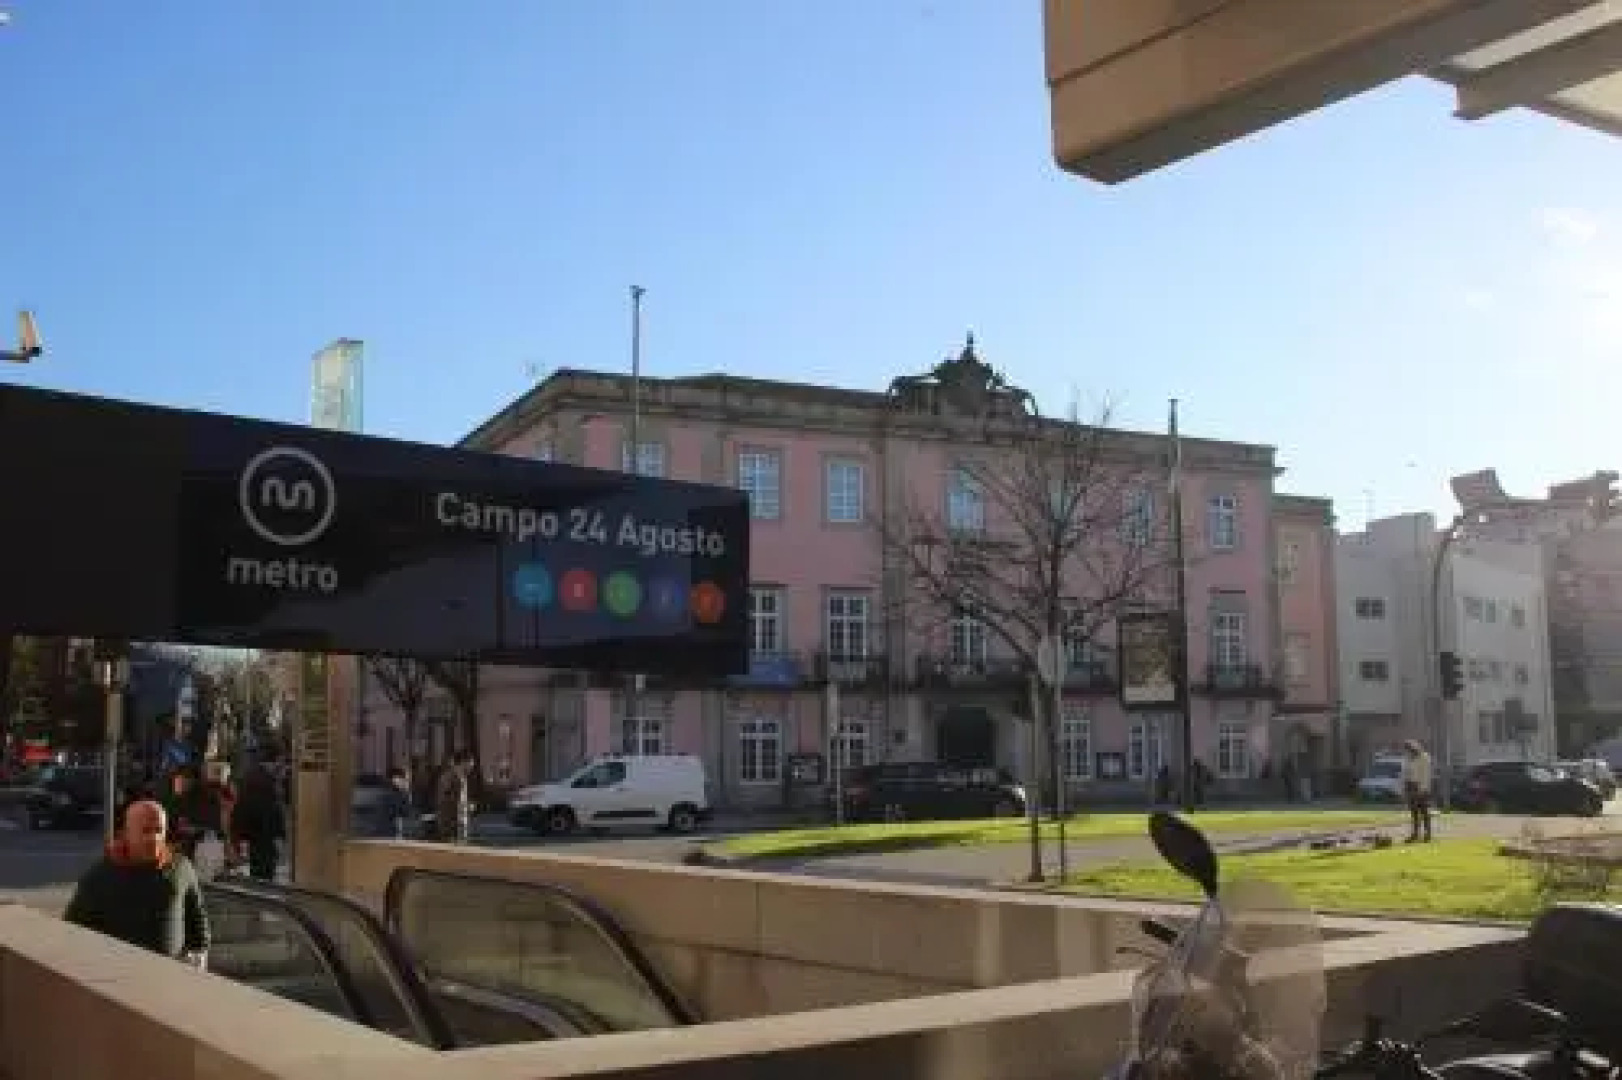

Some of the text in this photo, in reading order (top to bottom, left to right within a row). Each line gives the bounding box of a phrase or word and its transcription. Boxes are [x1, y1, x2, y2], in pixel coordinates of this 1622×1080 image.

[436, 492, 726, 557] Campo 24 Agosto
[227, 556, 338, 591] metro
